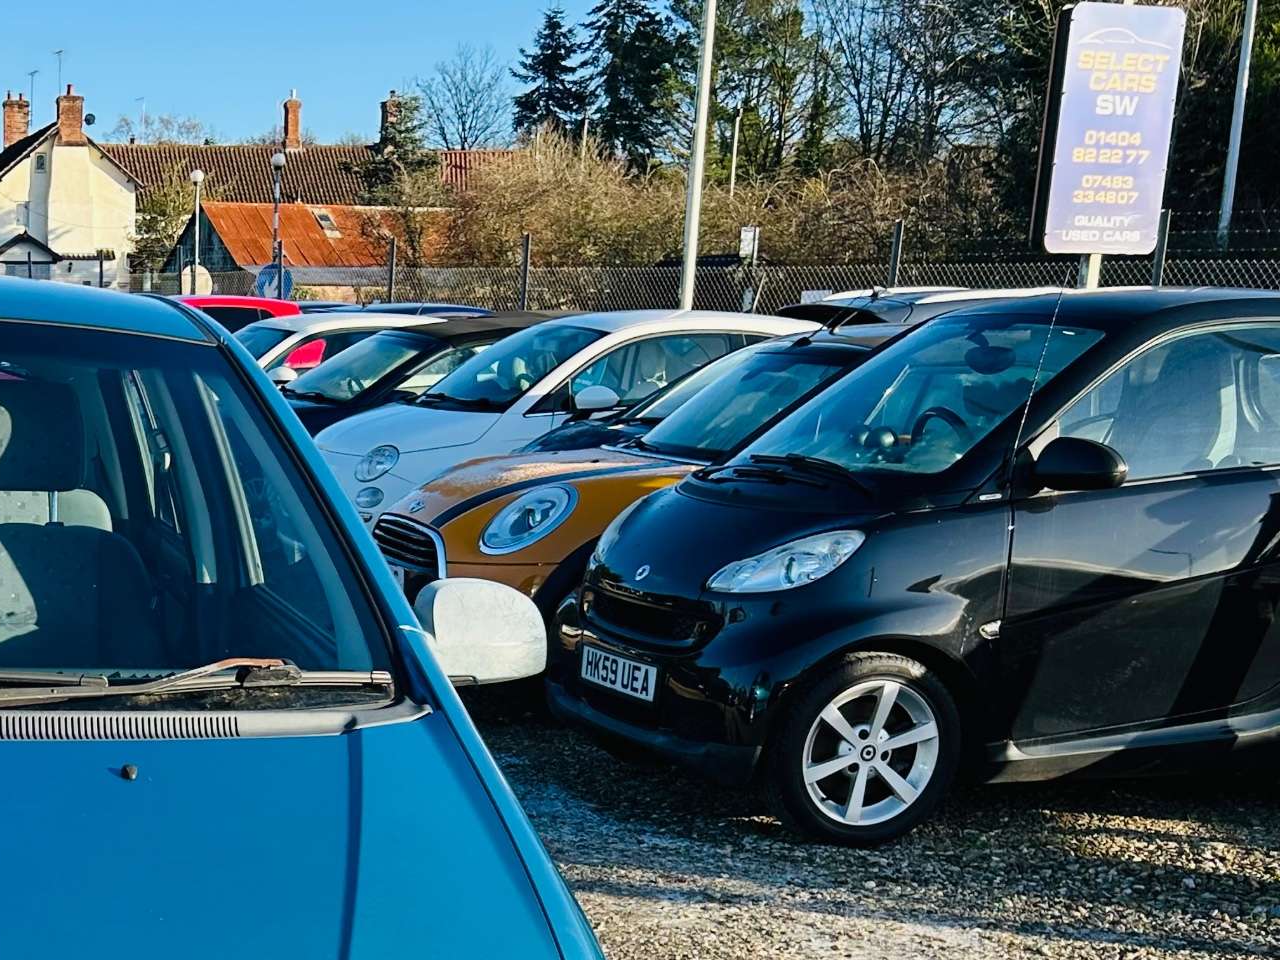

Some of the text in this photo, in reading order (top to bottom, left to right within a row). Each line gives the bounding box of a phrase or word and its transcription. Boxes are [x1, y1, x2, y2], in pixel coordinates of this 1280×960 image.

[1078, 52, 1169, 72] SELECT
[1089, 73, 1157, 93] CARS
[1095, 95, 1139, 116] SW
[1084, 129, 1141, 147] 01404
[1074, 215, 1131, 227] QUALITY
[1062, 230, 1141, 242] USED CARS
[585, 649, 649, 696] HK59 UEA
